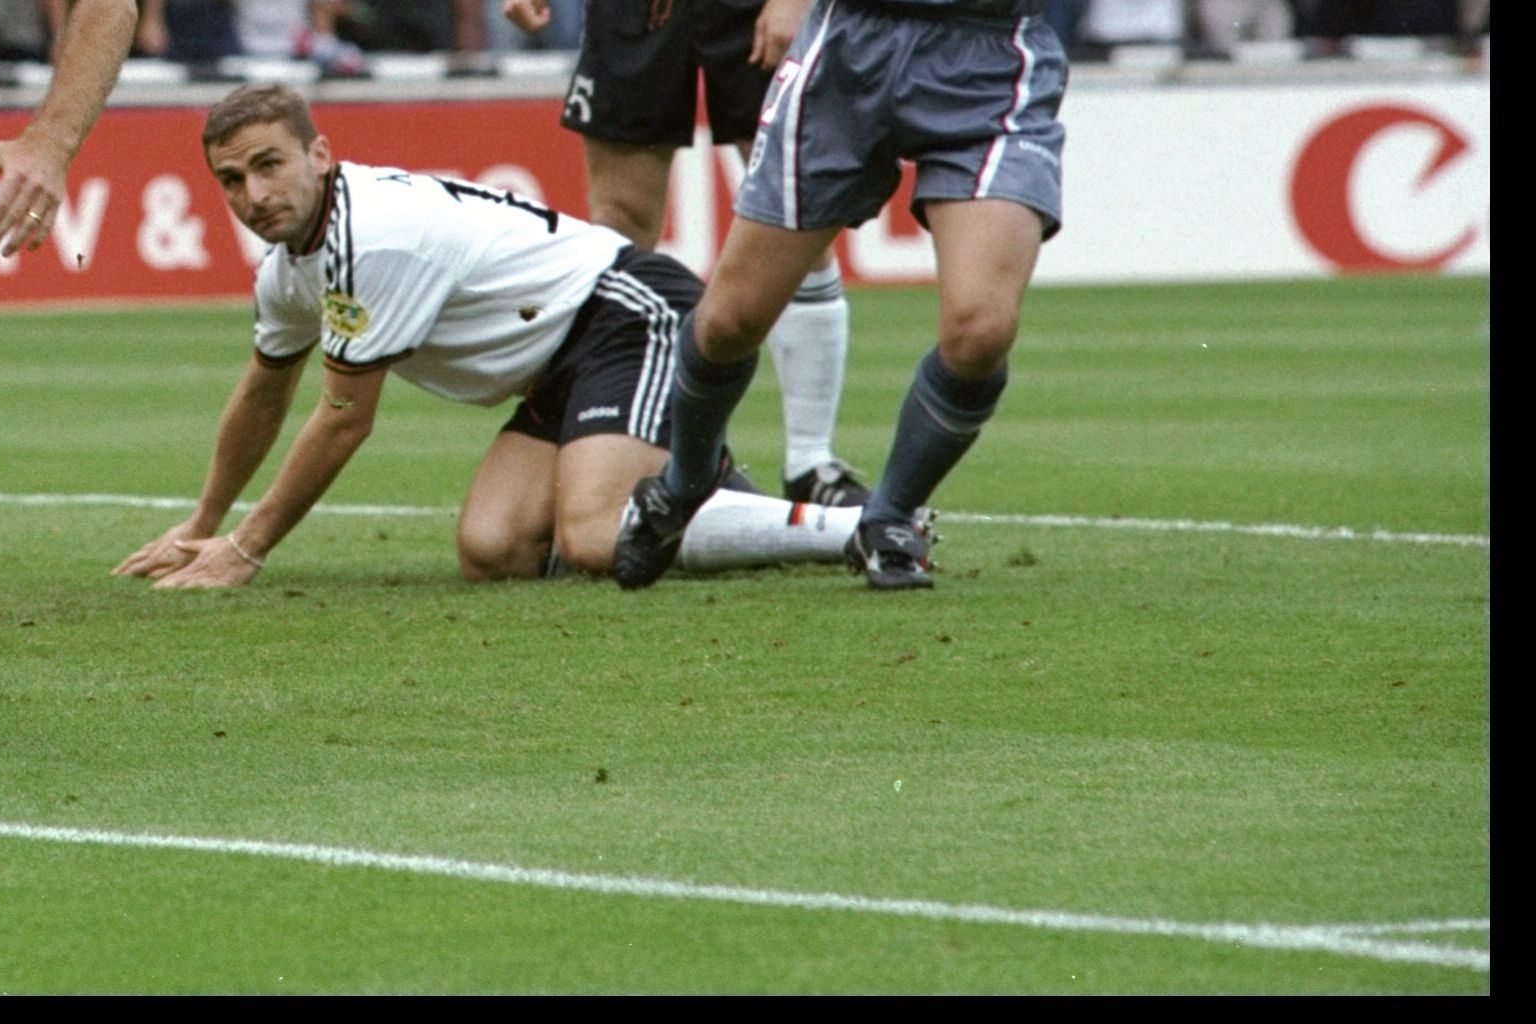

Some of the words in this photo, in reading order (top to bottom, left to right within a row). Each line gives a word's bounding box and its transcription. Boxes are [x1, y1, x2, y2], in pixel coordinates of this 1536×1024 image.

[564, 74, 594, 123] 5
[759, 57, 802, 126] 7
[138, 174, 209, 270] &
